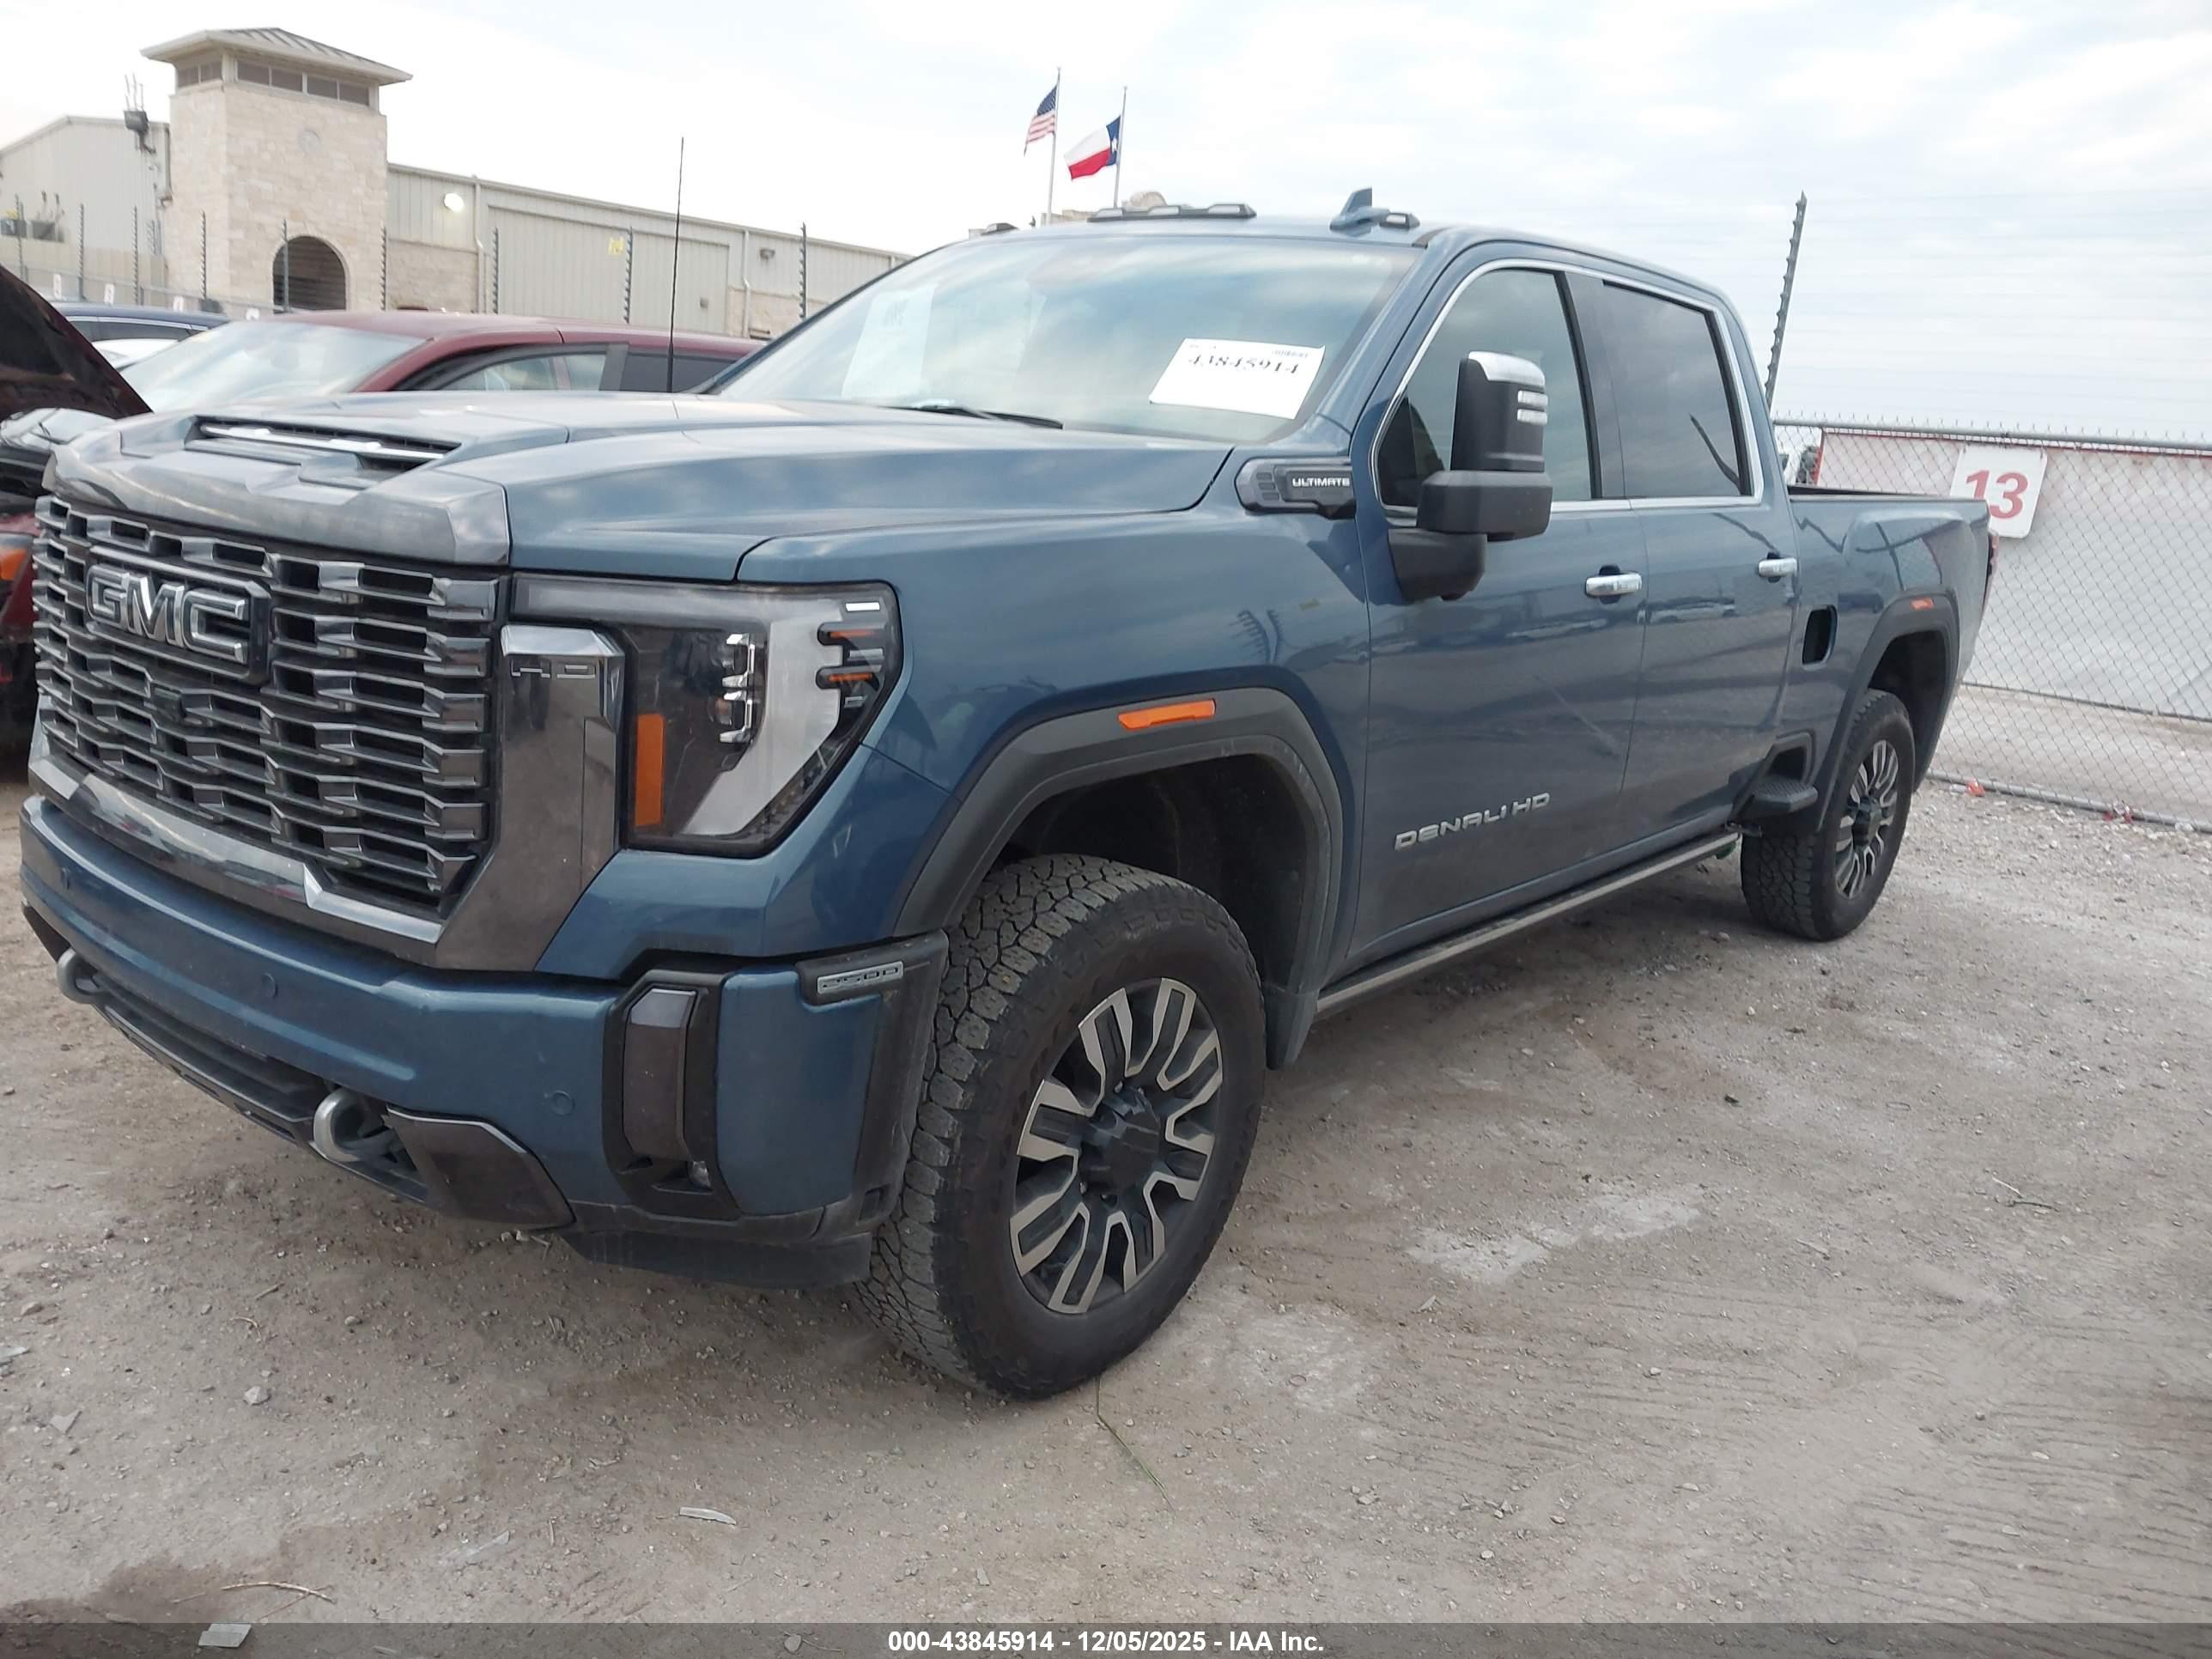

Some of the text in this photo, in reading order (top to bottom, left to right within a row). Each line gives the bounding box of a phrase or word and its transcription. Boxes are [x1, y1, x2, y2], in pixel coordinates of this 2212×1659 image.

[1291, 477, 1350, 487] ULTIMATE
[1966, 470, 2028, 519] 13
[87, 563, 249, 665] GMC
[1395, 793, 1550, 850] DENALI HD
